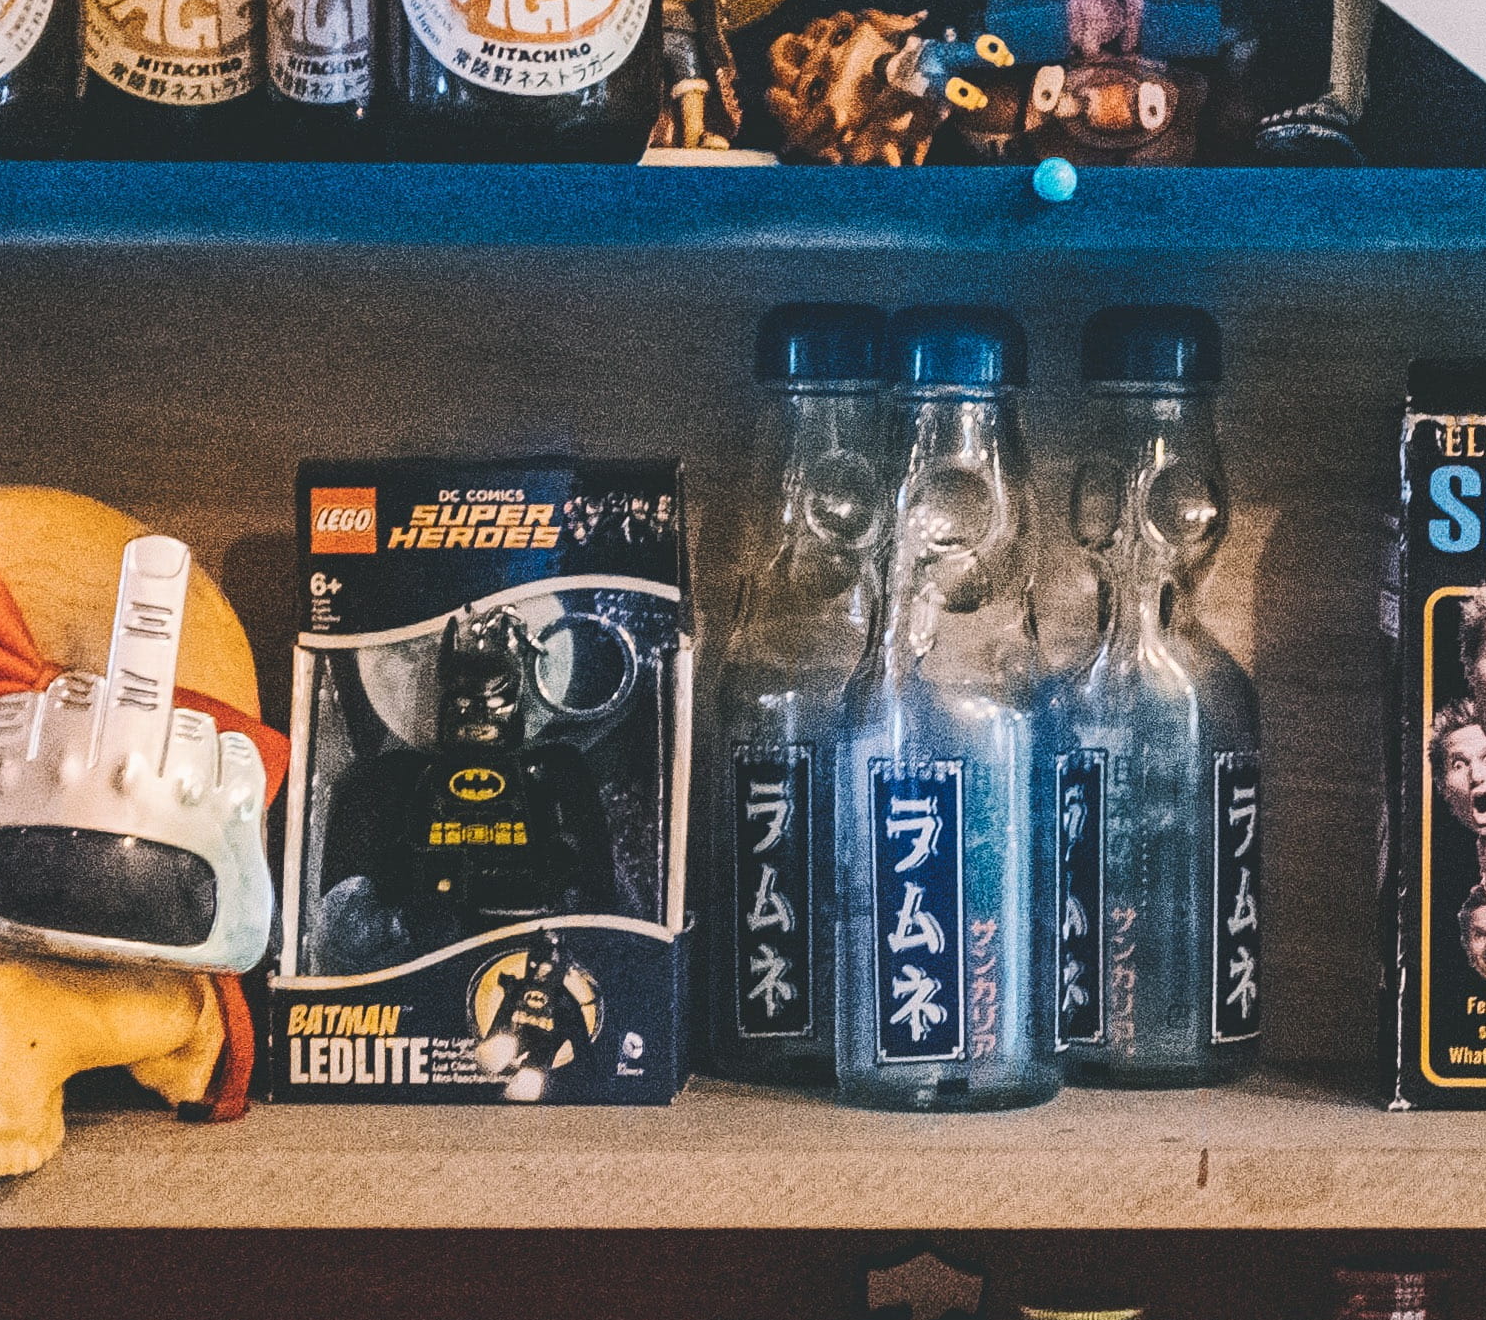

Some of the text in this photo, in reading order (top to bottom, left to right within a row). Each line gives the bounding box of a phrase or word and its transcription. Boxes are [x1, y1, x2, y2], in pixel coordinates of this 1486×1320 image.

[480, 41, 593, 67] HITACHINO
[438, 489, 526, 503] DC COMICS
[316, 507, 372, 533] LEGO
[409, 503, 555, 528] SUPER
[387, 526, 562, 550] HEROES
[310, 571, 343, 598] 6+
[744, 780, 798, 1020] ラムネ
[885, 795, 947, 1042] ラムネ
[287, 1003, 402, 1037] BATMAN
[289, 1036, 431, 1085] LEDLITE
